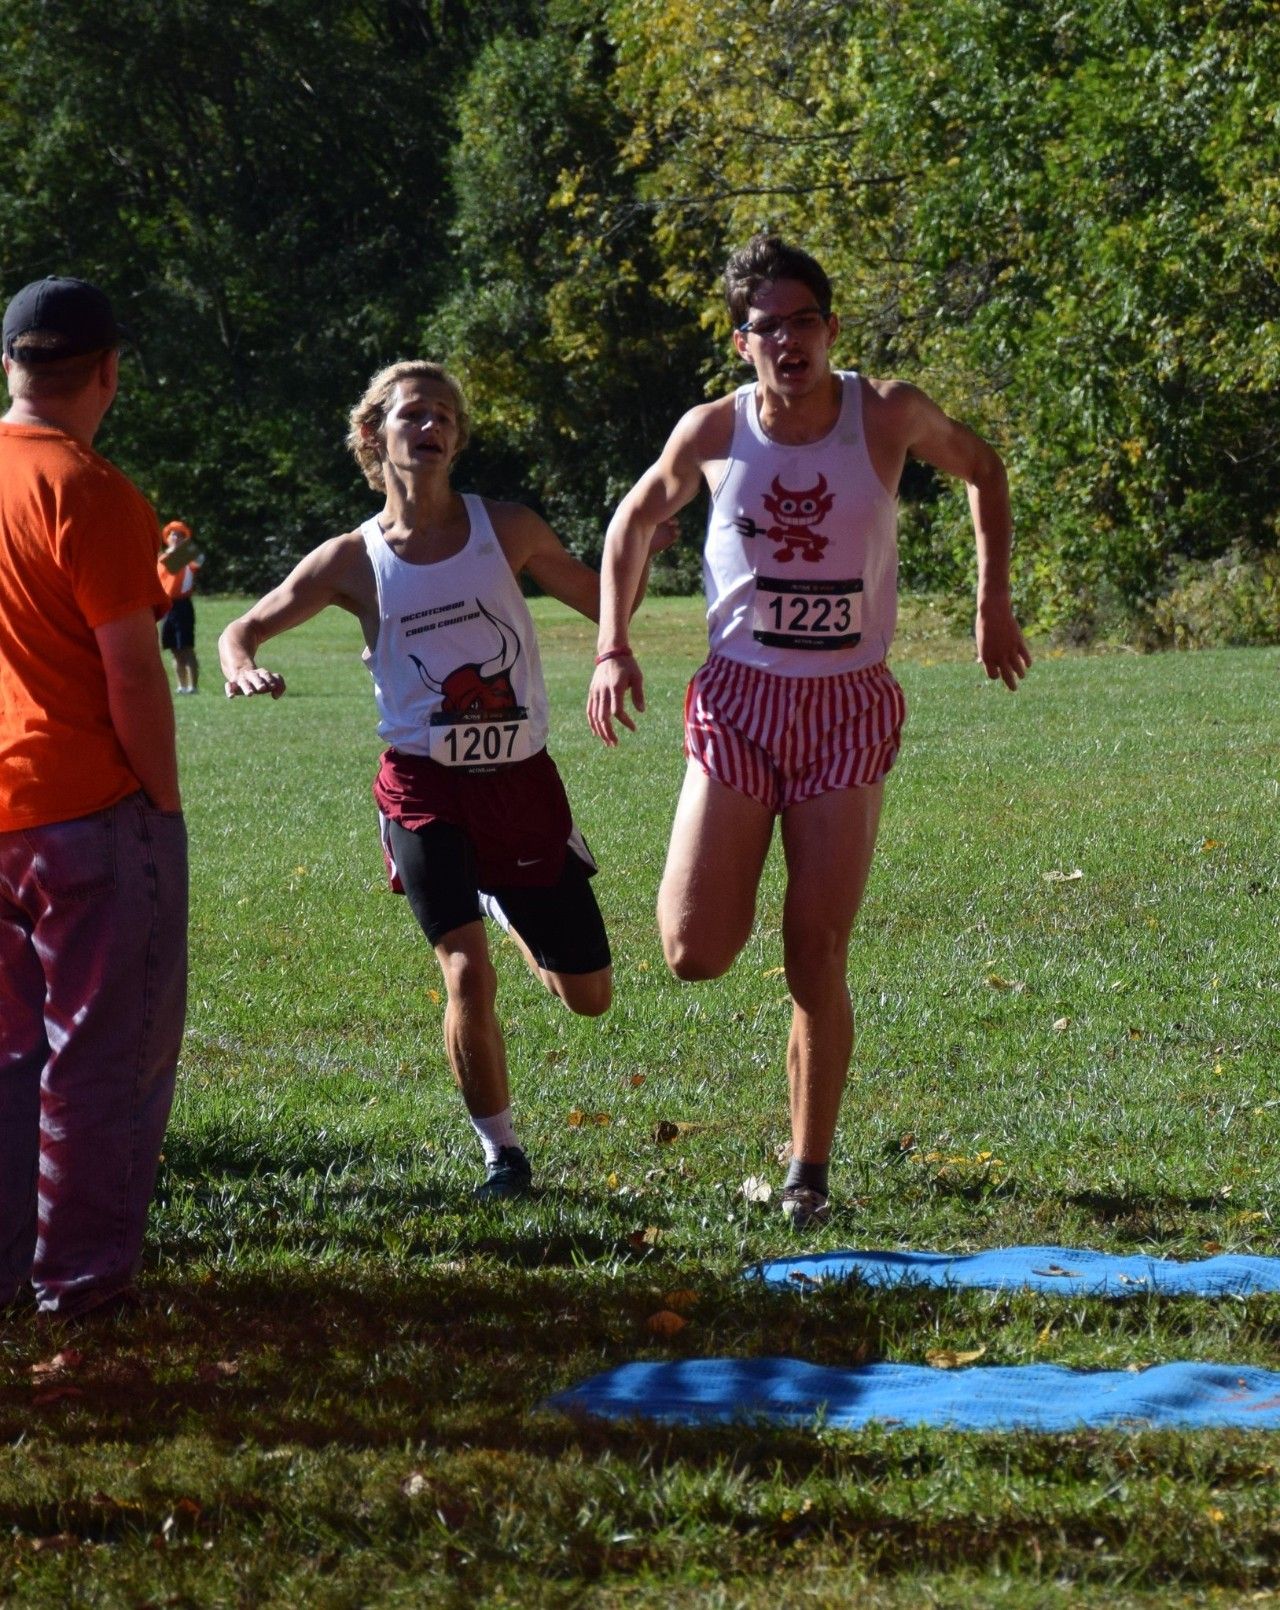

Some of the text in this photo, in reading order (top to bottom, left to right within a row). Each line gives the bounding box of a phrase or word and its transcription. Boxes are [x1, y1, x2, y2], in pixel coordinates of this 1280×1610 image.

[405, 611, 480, 638] CROSS COUNTRY
[768, 596, 852, 633] 1223
[444, 724, 520, 762] 1207
